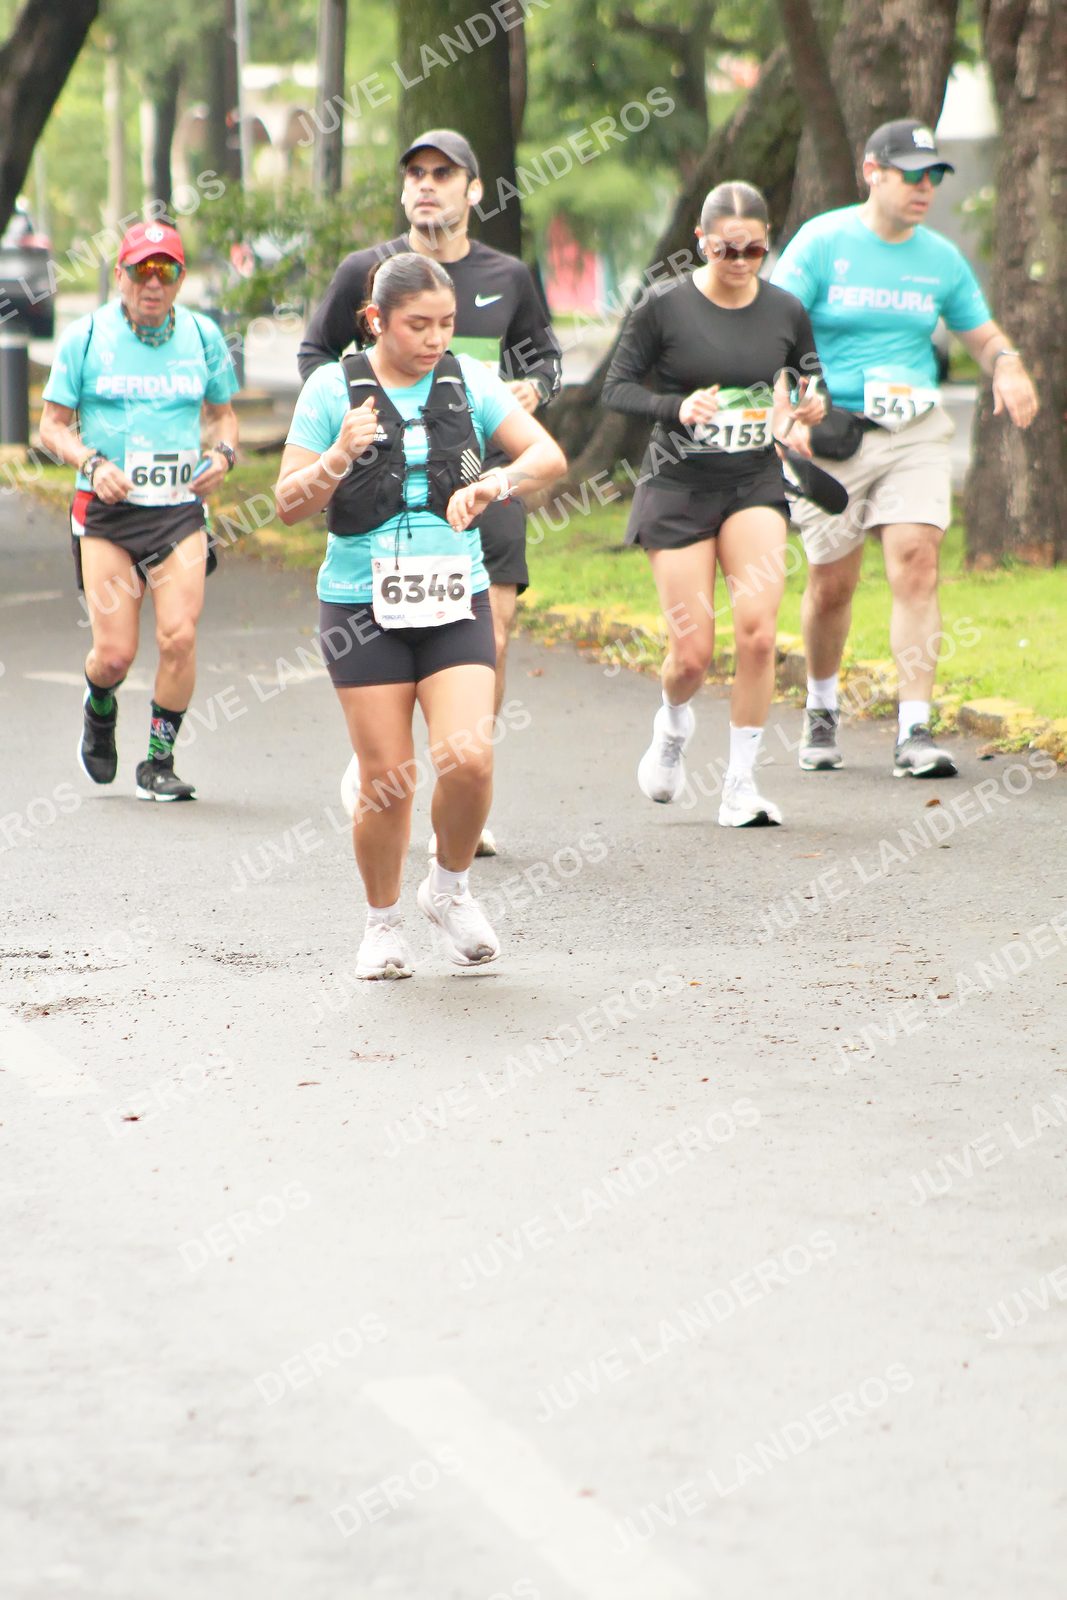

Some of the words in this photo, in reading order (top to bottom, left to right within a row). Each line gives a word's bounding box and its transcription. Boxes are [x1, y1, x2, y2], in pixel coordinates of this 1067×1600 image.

[827, 284, 934, 312] PERDURA
[702, 422, 767, 447] 2153
[132, 464, 192, 486] 6610
[381, 573, 465, 604] 6346
